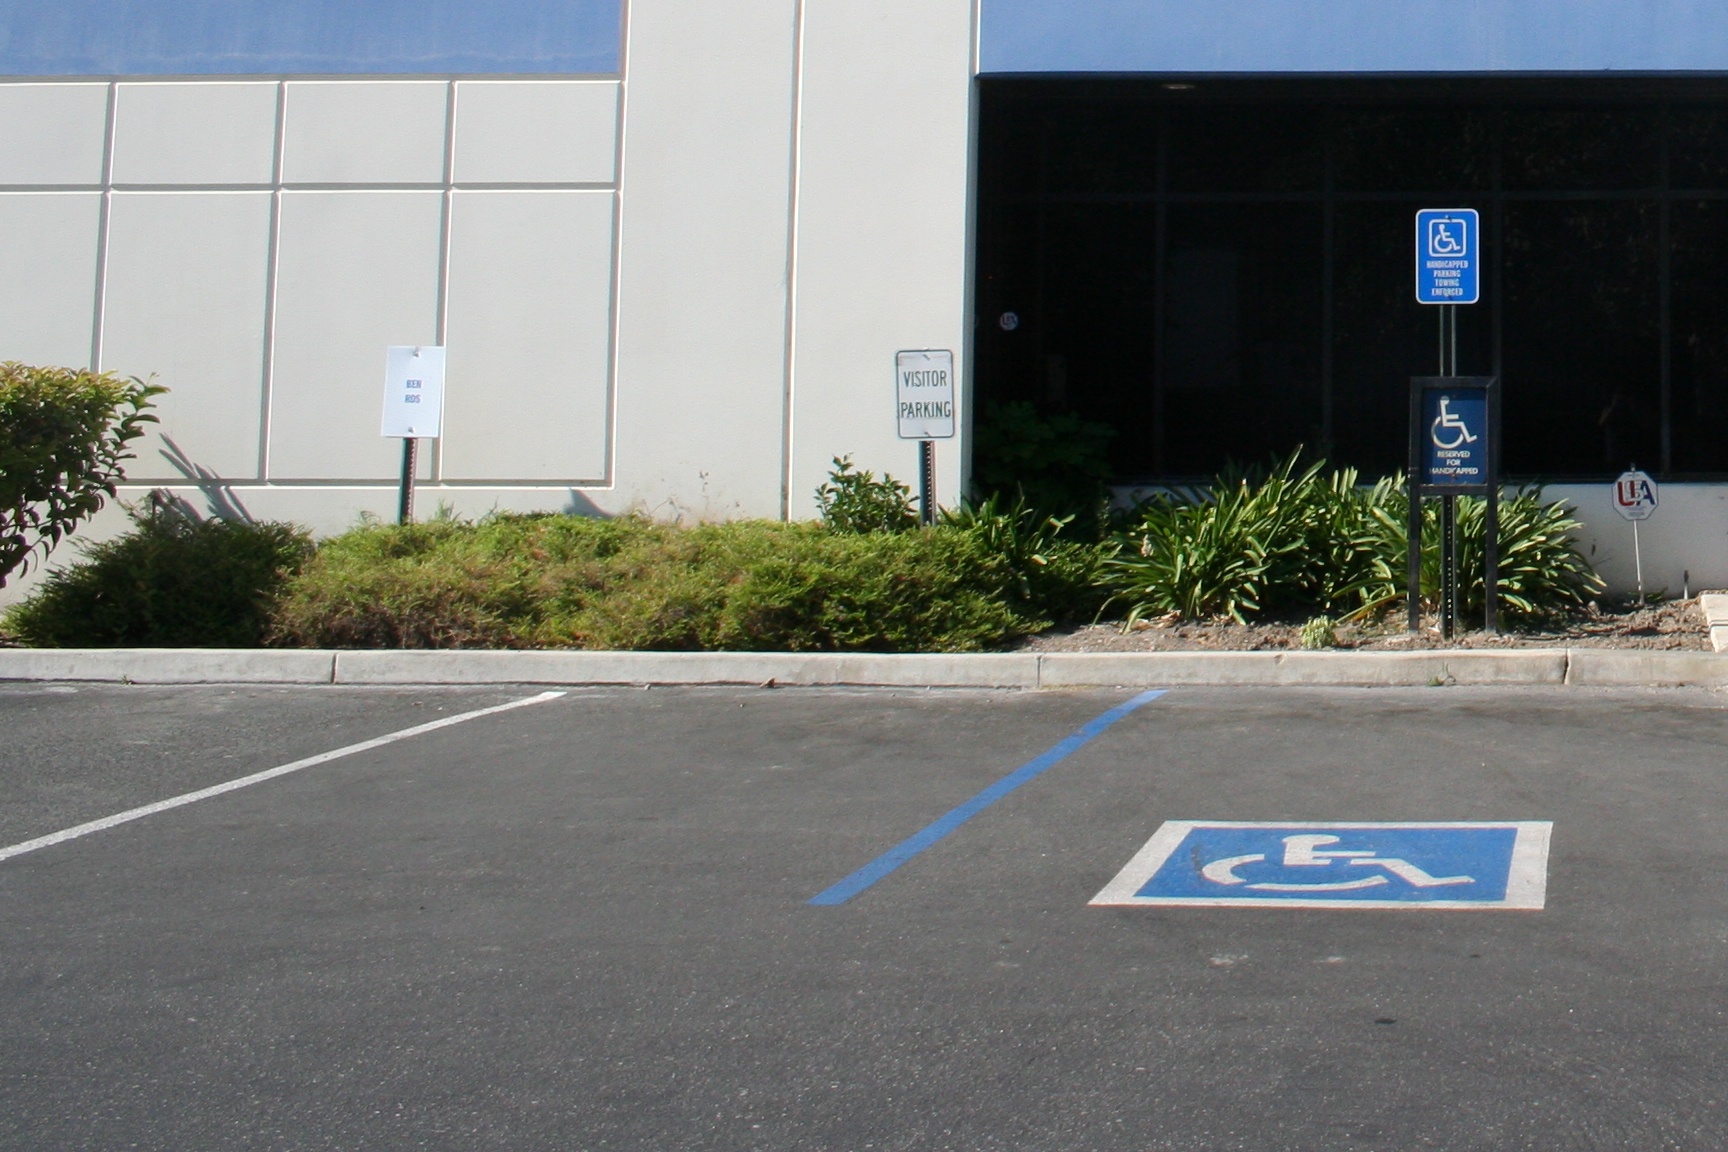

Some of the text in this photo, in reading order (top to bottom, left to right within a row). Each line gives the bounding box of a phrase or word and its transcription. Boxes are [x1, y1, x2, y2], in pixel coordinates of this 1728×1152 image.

[1427, 260, 1468, 268] HANDICAPPED
[1431, 288, 1463, 296] ENFORCED
[903, 370, 947, 387] VISITOR
[900, 401, 951, 418] PARKING
[1437, 450, 1471, 458] RESERVED
[1446, 458, 1461, 466] FOR
